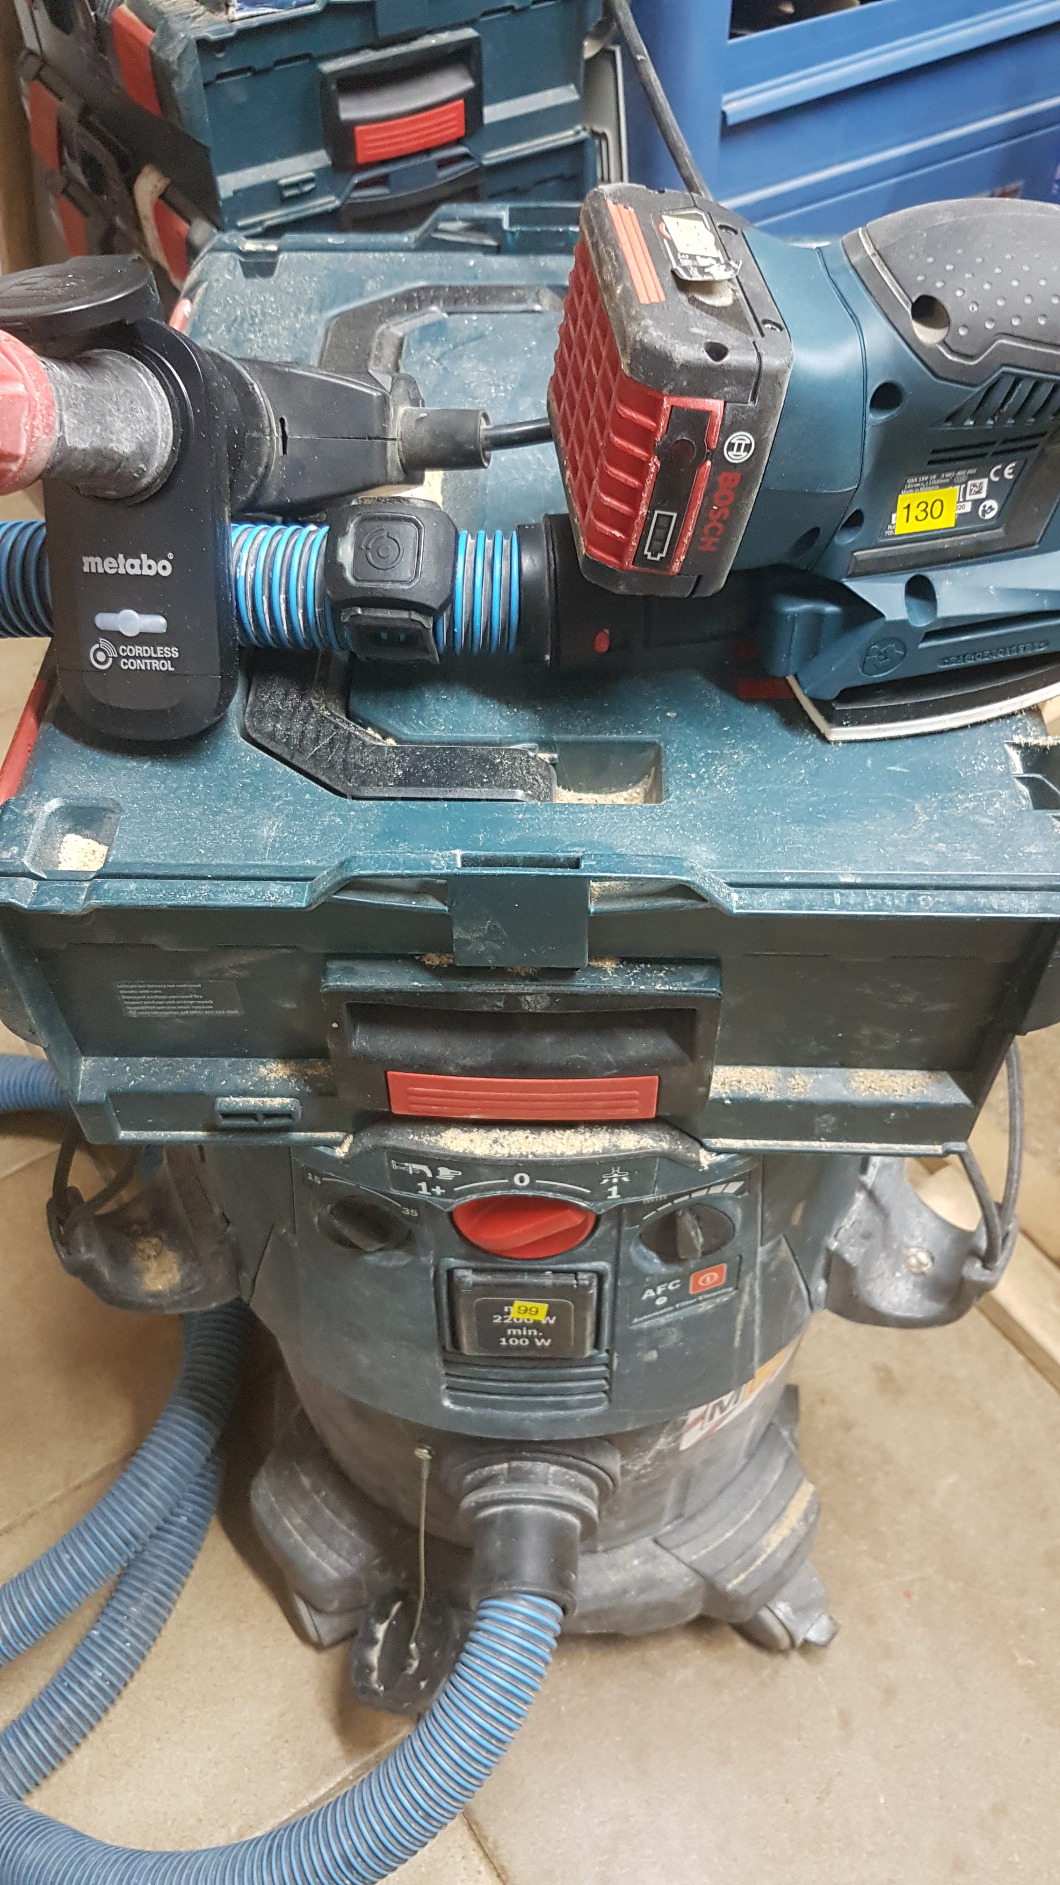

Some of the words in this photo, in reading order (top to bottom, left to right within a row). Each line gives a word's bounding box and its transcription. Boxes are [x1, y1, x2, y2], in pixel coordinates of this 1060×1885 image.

[699, 471, 742, 552] BOSCH
[903, 498, 944, 523] 130
[82, 553, 173, 577] metabo
[119, 645, 179, 659] CORDLESS
[120, 659, 175, 671] CONTROL
[417, 1181, 446, 1196] 1+
[606, 1185, 622, 1199] 1
[401, 1207, 419, 1217] 35
[641, 1279, 682, 1300] AFC
[517, 1304, 540, 1317] 99
[506, 1326, 543, 1336] min.
[499, 1337, 530, 1346] 100
[534, 1337, 552, 1346] W
